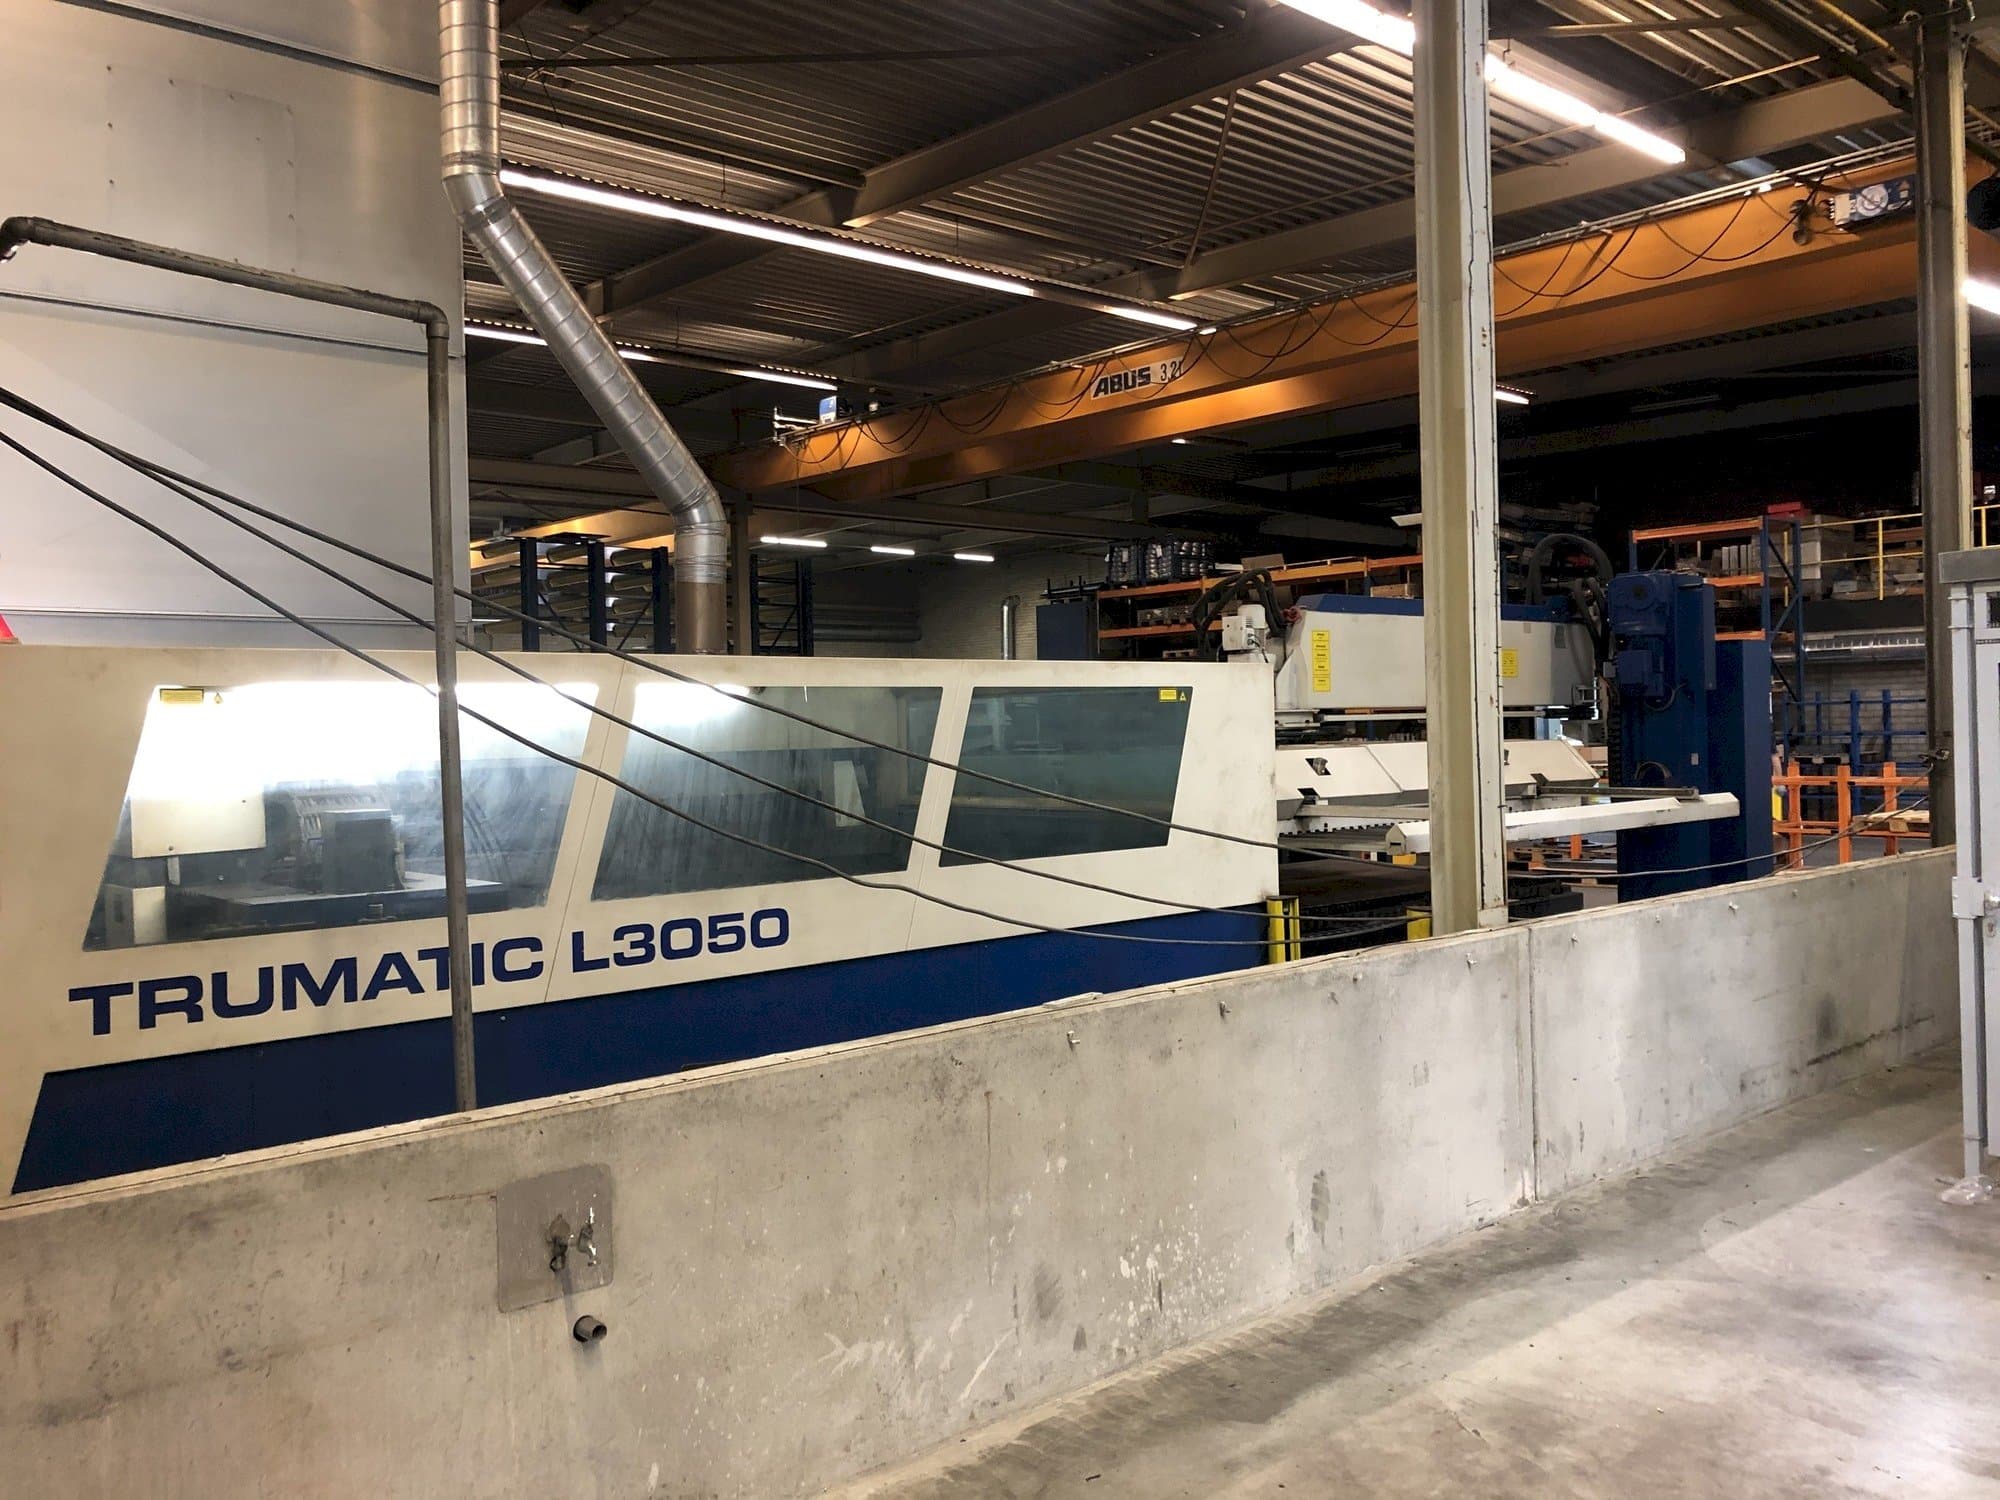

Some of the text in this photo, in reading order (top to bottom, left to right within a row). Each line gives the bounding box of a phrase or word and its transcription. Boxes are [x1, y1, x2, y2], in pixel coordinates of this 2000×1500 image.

[1093, 366, 1150, 398] ABUS
[69, 907, 790, 1036] TRUMATIC L3050
